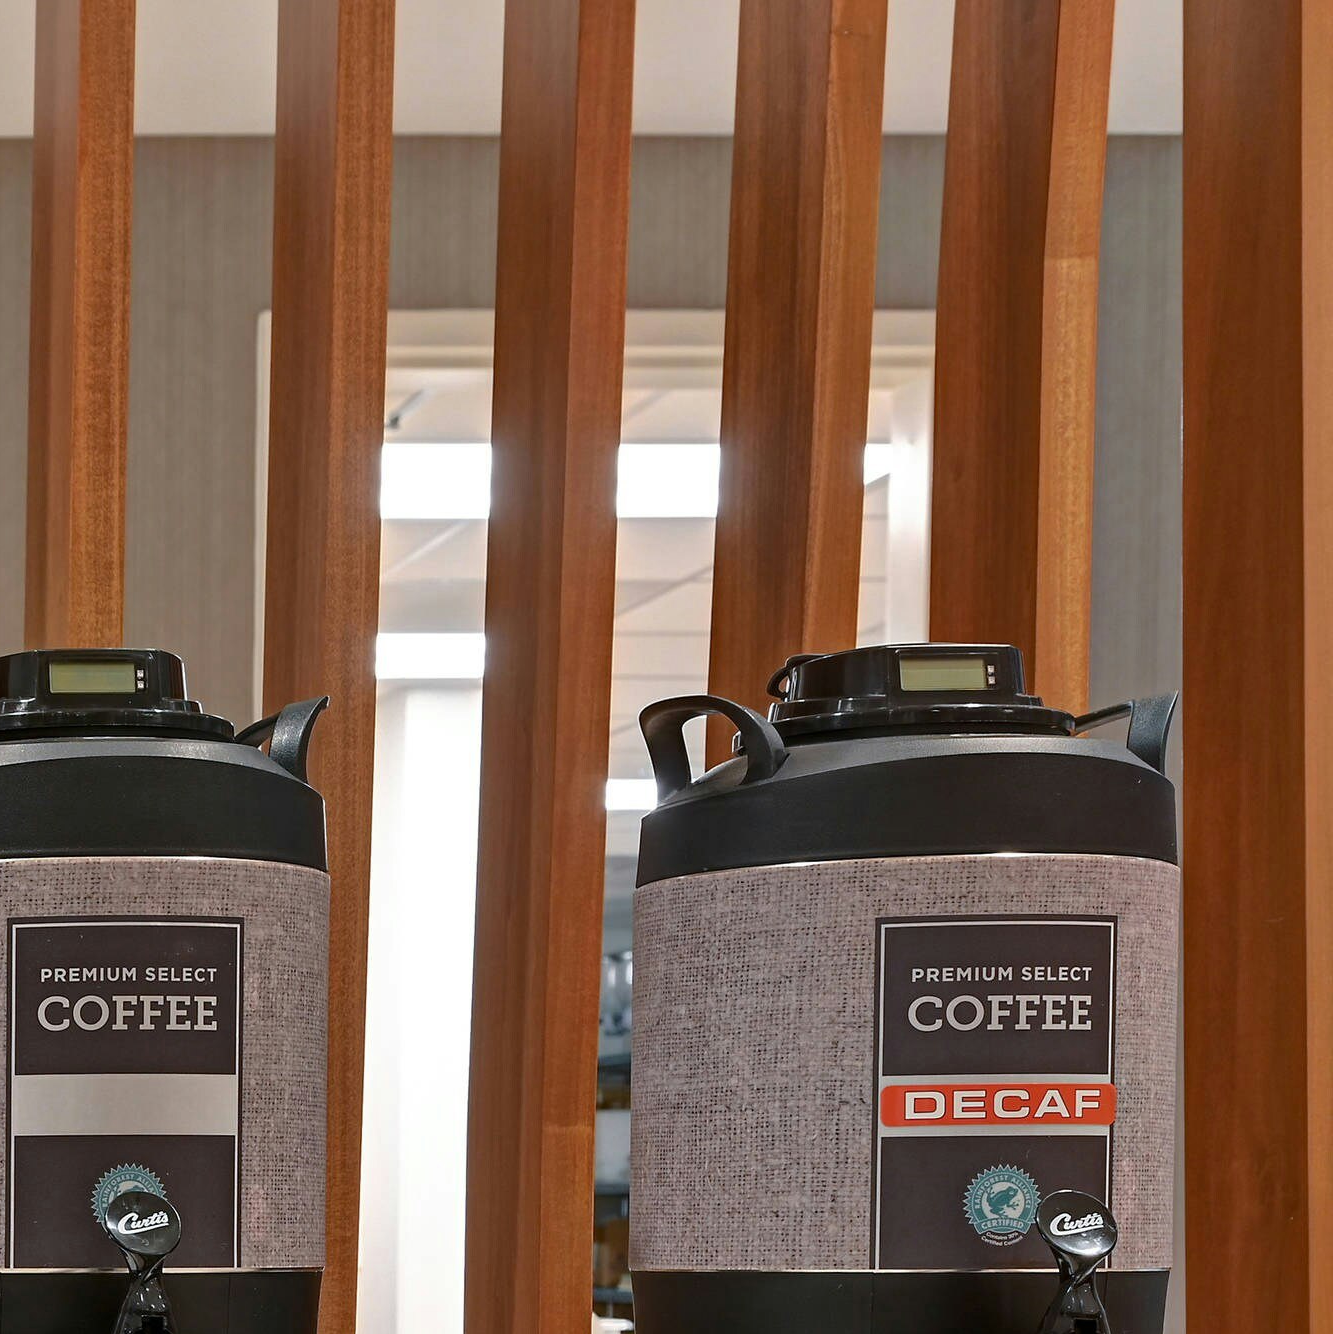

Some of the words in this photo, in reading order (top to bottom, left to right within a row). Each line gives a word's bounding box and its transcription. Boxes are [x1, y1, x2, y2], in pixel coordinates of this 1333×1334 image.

[40, 967, 137, 983] PREMIUM
[145, 967, 218, 983] SELECT
[911, 966, 1013, 983] PREMIUM
[1021, 966, 1092, 982] SELECT
[37, 995, 218, 1031] COFFEE
[908, 994, 1092, 1032] COFFEE
[904, 1089, 1101, 1120] DECAF
[102, 1174, 135, 1208] RAINFOREST
[975, 1175, 1009, 1209] RAINFOREST
[1010, 1177, 1032, 1209] ALLIANCE
[118, 1211, 169, 1235] Curtis
[981, 1219, 1024, 1229] CERTIFIED
[1050, 1212, 1105, 1236] Curtis
